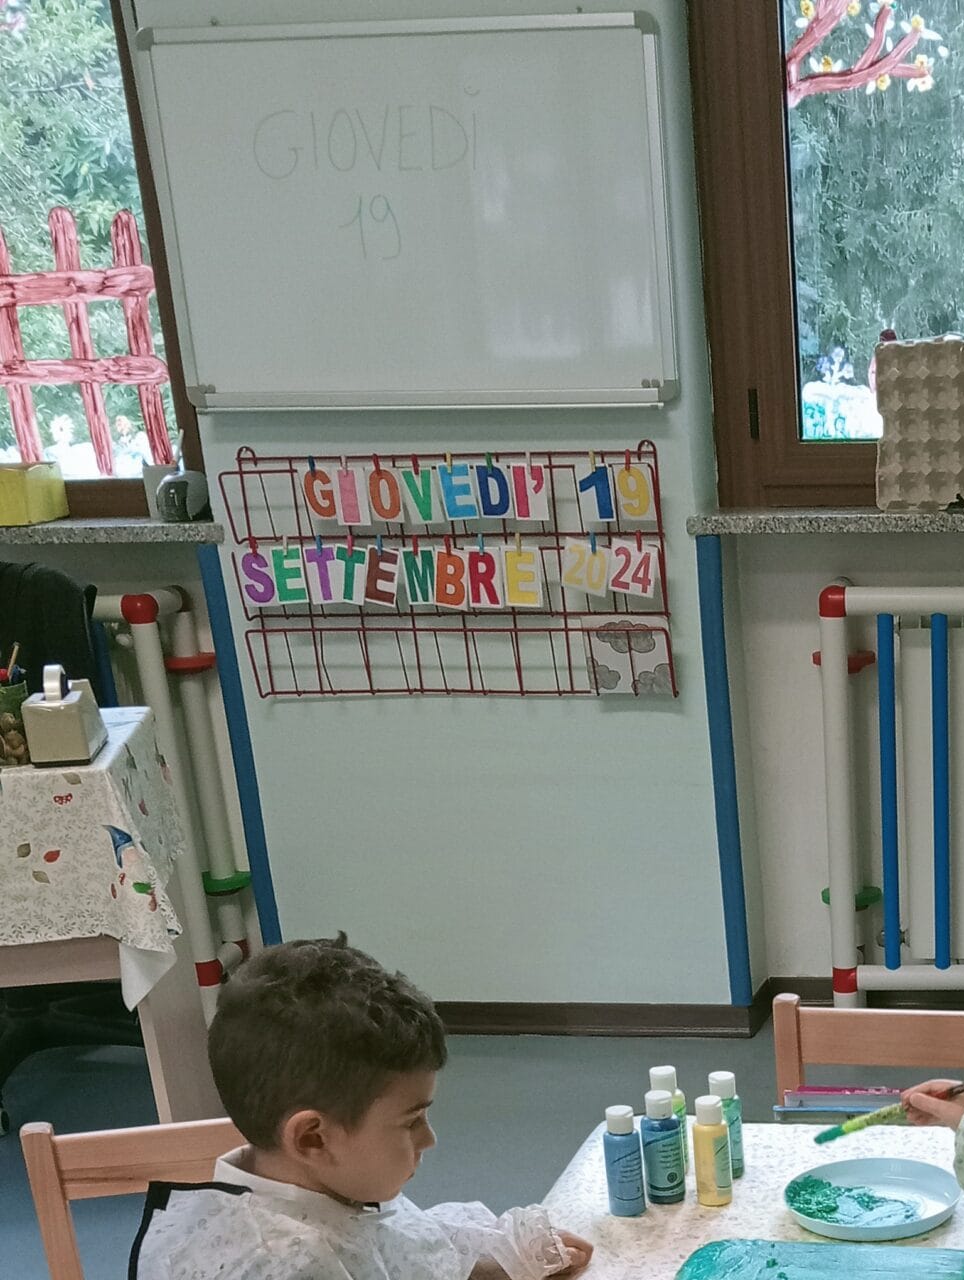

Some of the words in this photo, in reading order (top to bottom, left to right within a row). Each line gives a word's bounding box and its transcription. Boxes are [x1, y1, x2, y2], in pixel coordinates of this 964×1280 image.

[338, 193, 402, 260] 19
[578, 465, 651, 518] 19
[241, 547, 541, 606] SETTEMBRE
